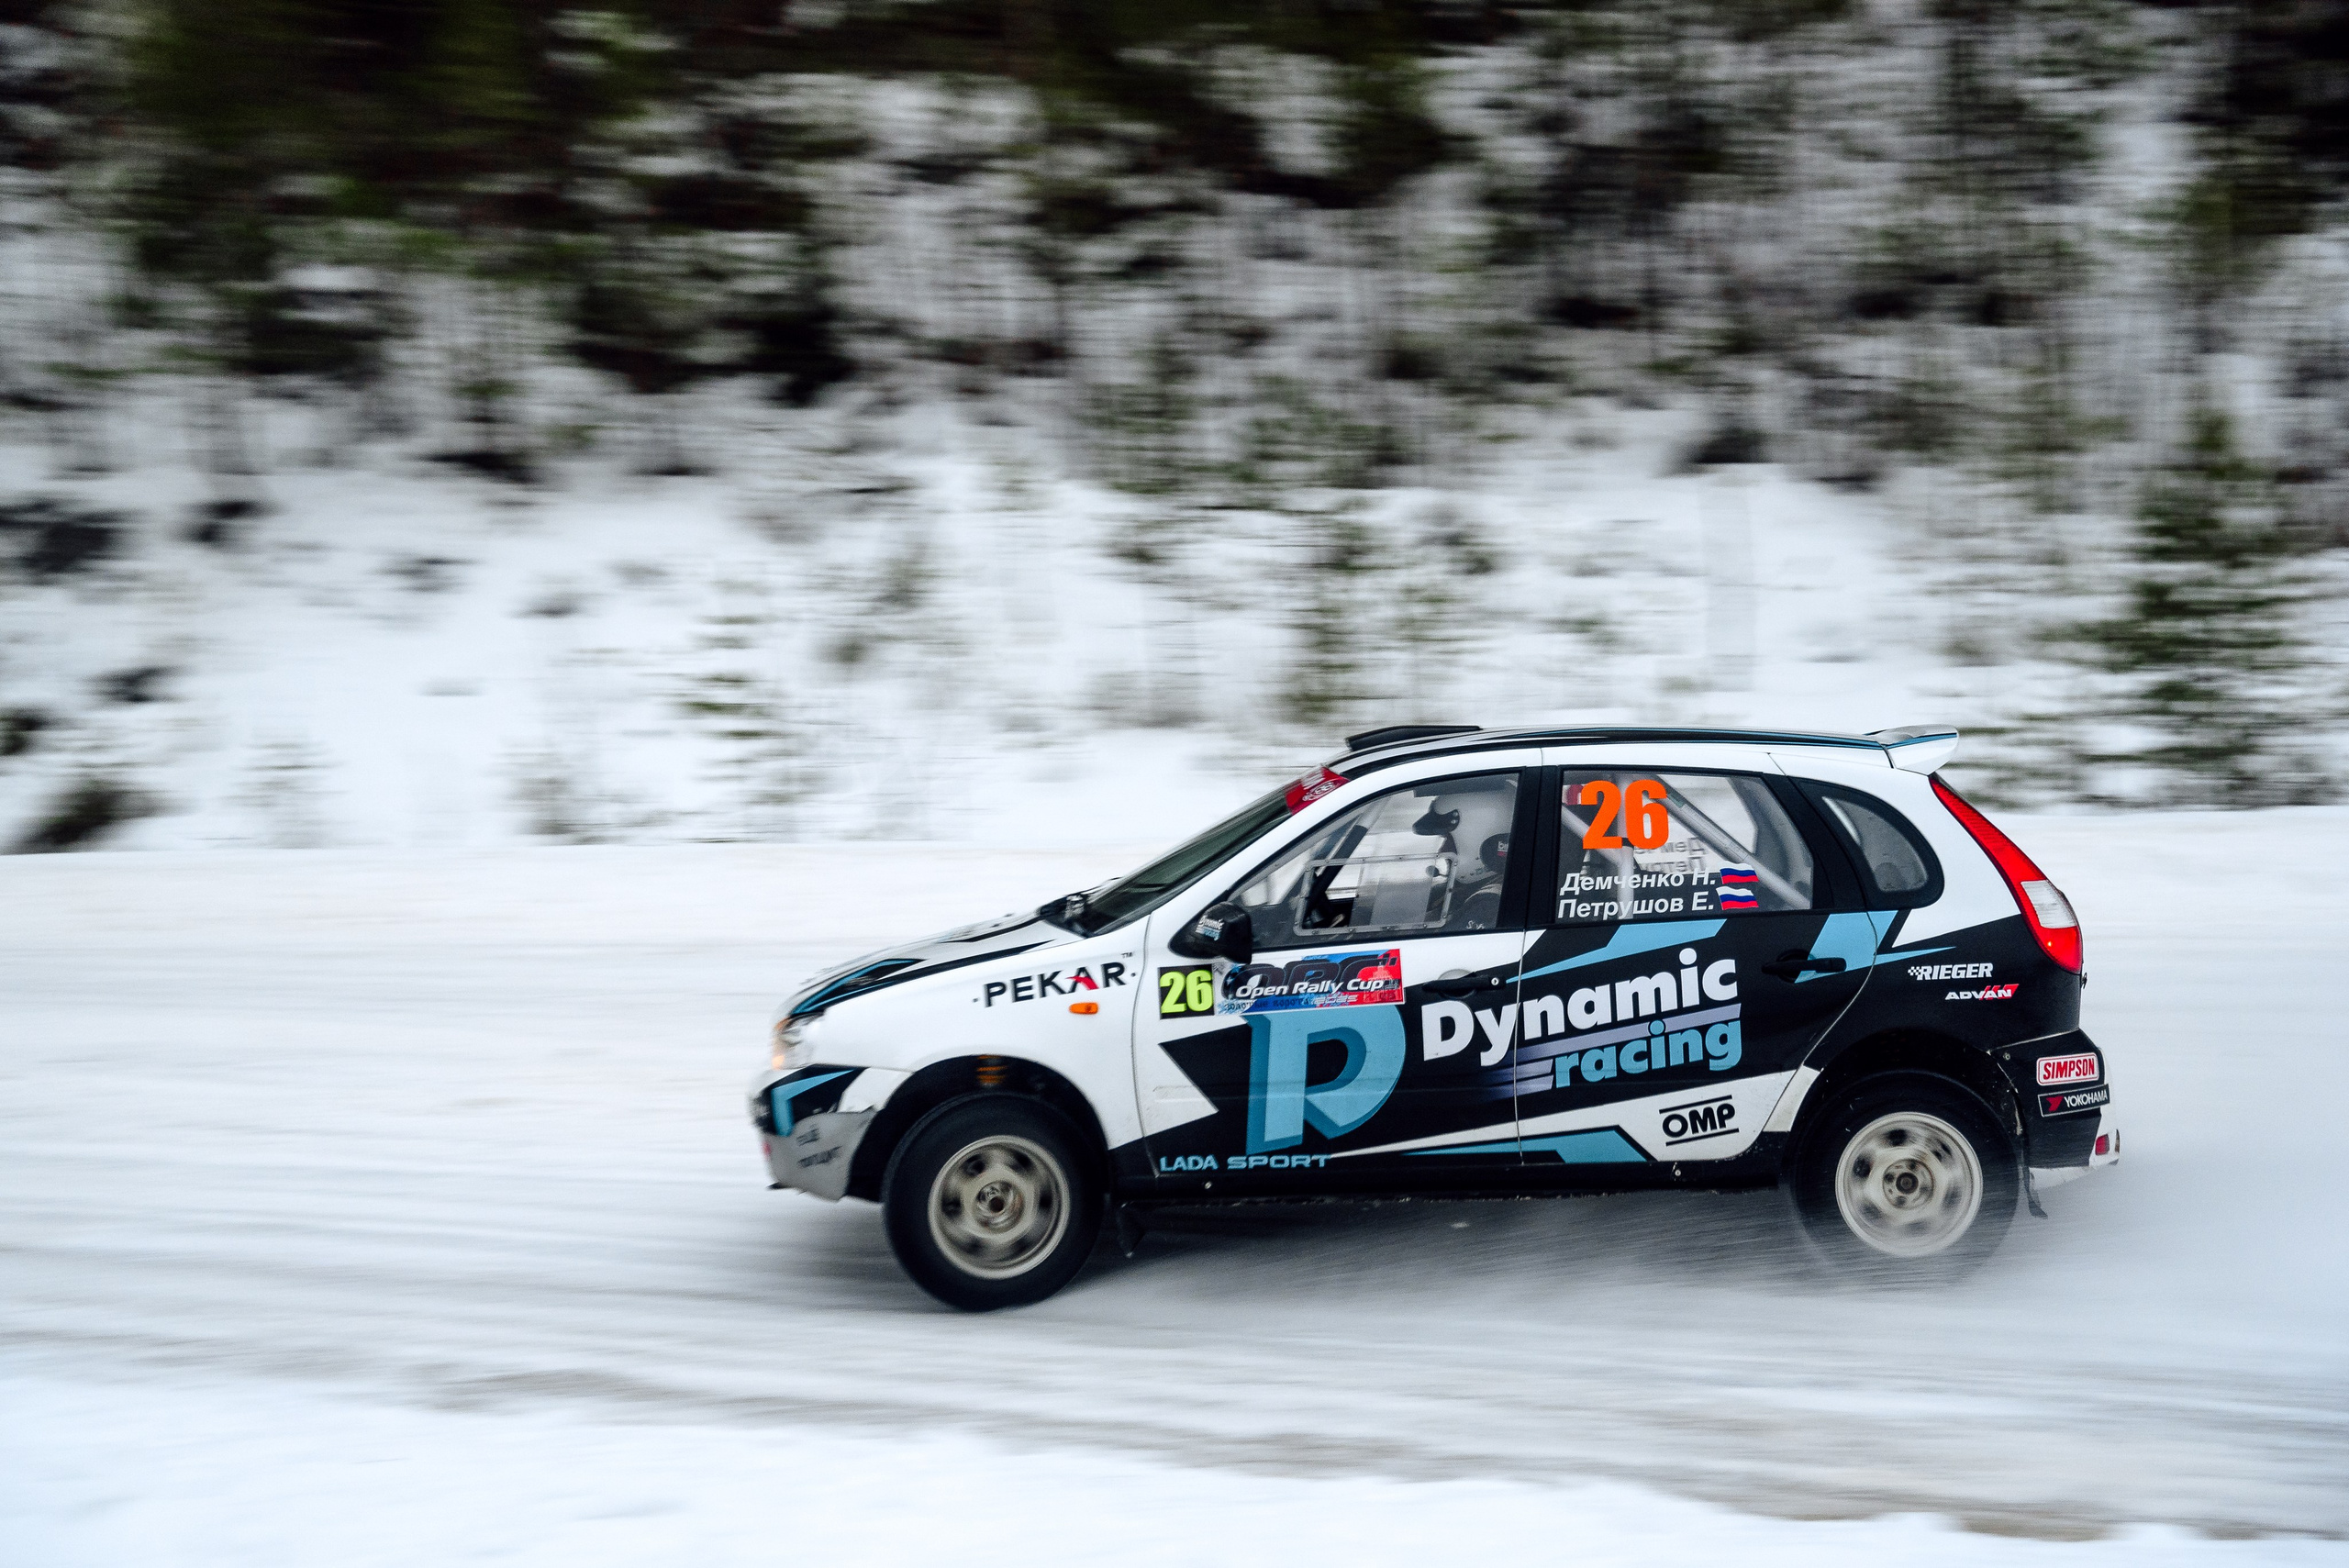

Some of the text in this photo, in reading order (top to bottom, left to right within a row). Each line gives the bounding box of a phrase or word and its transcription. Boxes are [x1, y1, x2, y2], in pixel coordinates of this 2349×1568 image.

[1580, 779, 1669, 850] 26
[1559, 872, 1685, 896] Демченко
[1557, 895, 1685, 920] Петрушов
[1916, 962, 1994, 981] RIEGER
[983, 962, 1127, 1008] PEKAR
[1159, 969, 1214, 1015] 26
[1235, 978, 1386, 1000] Open Rally Cup
[1944, 988, 2012, 1001] ADVAN
[1421, 947, 1739, 1067] Dynamic
[1555, 1019, 1742, 1090] racing
[2043, 1057, 2095, 1080] SIMPSON
[2064, 1088, 2109, 1108] YOKOHAMA
[1662, 1102, 1736, 1139] OMP
[1160, 1153, 1331, 1172] LADA SPORT
